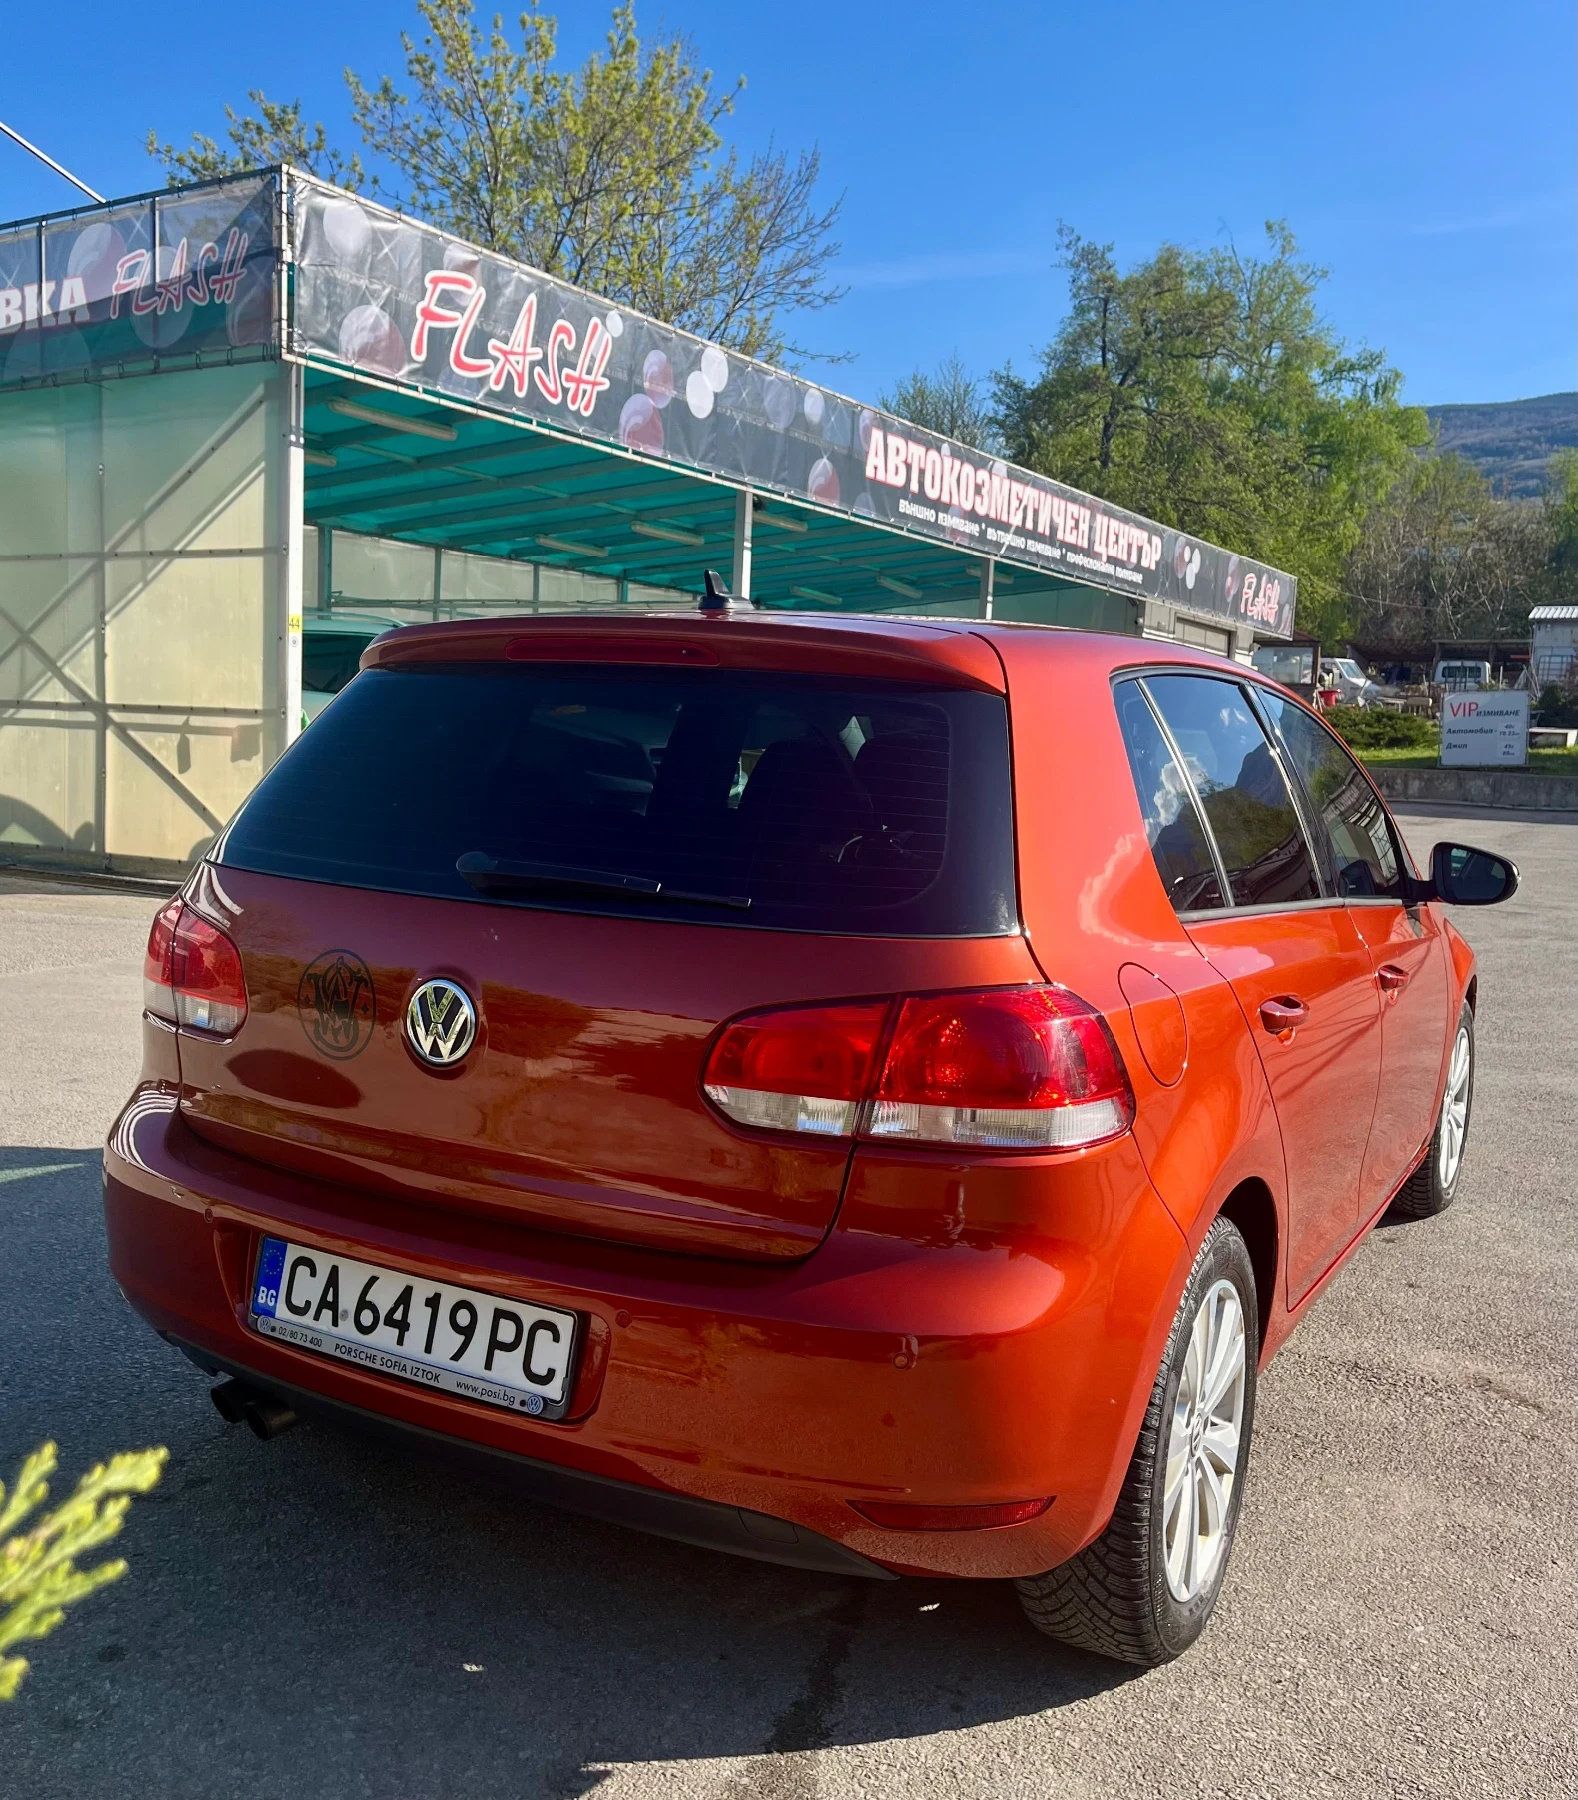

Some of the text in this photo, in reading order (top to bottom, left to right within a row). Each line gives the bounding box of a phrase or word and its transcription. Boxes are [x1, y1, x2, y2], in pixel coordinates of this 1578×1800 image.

[111, 227, 249, 319] FLASH
[410, 270, 612, 416] FLASH
[864, 426, 1091, 547] АВТОКОЗМЕТИЧЕН
[1094, 512, 1162, 571] ЦЕНТЪР
[1449, 702, 1479, 717] VIP
[257, 1286, 277, 1307] BG
[354, 1275, 479, 1362] 6419
[300, 1333, 308, 1343] 73
[309, 1337, 323, 1348] 400
[334, 1343, 377, 1365] PORSCHE
[379, 1356, 408, 1374] SOFIA
[410, 1366, 441, 1384] IZTOK
[456, 1379, 516, 1406] www.posi.bg
